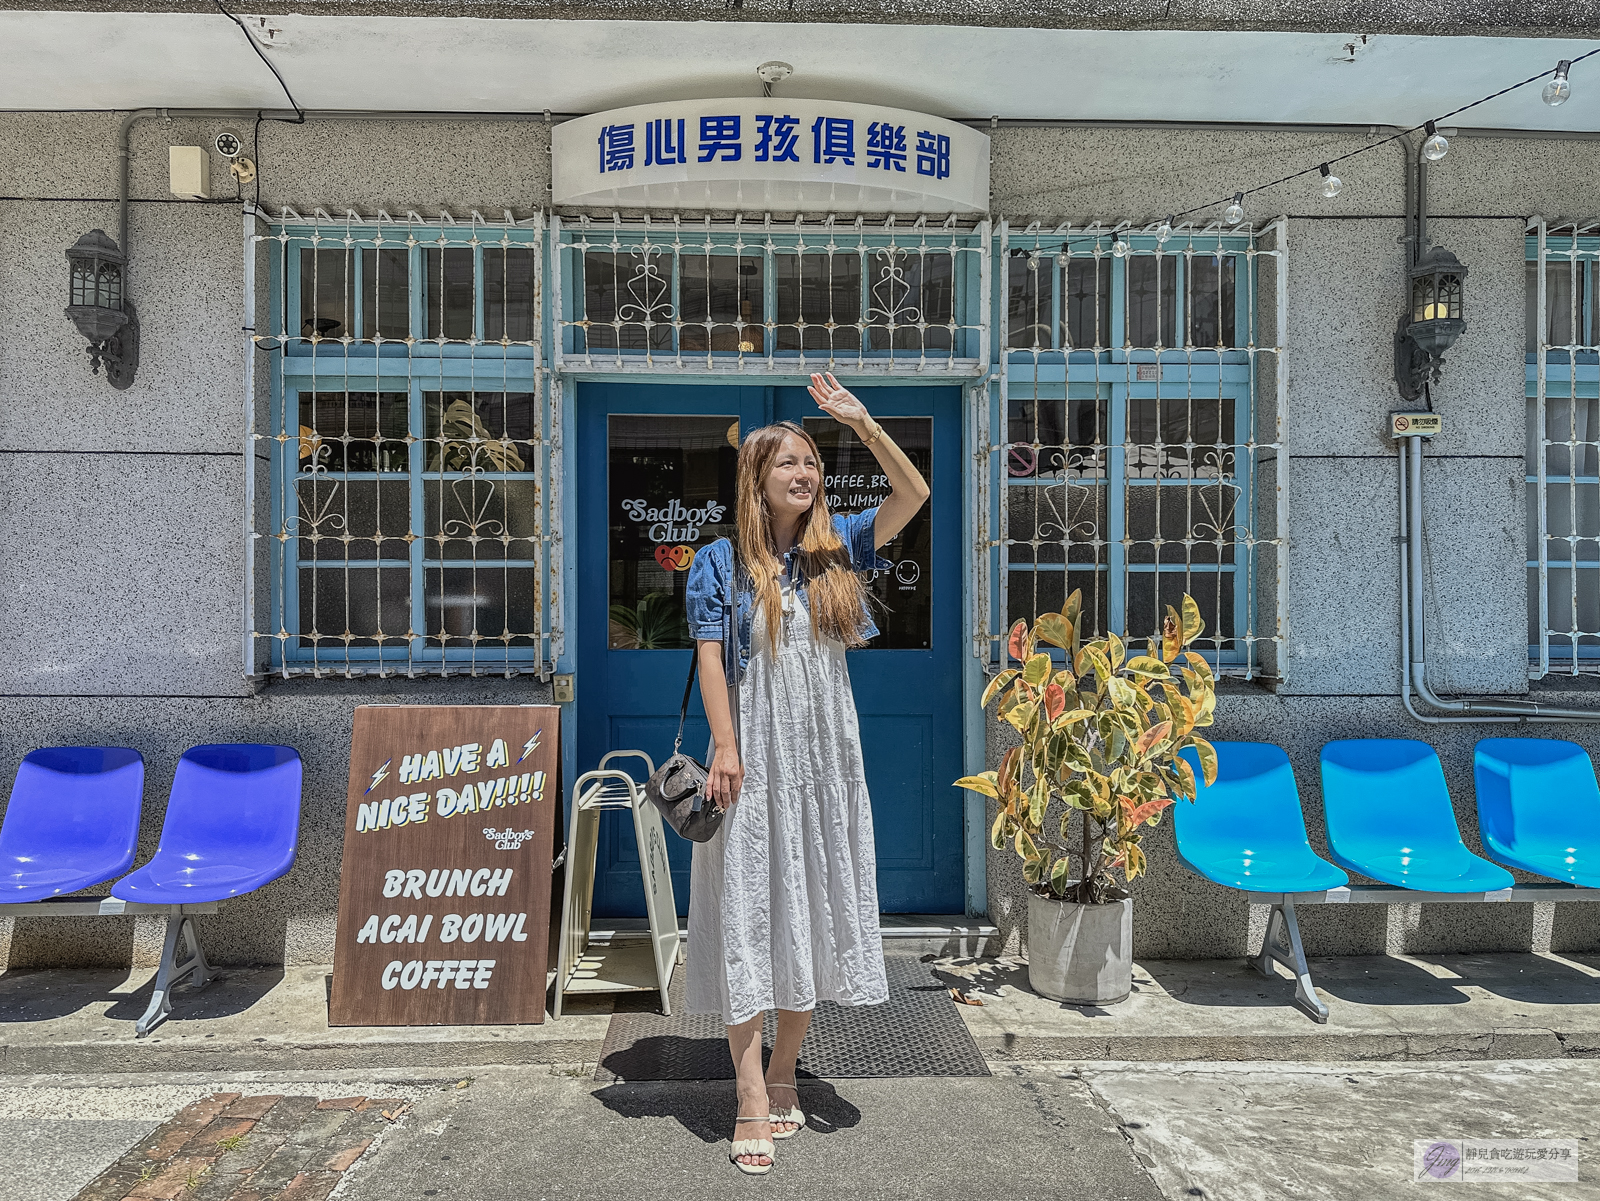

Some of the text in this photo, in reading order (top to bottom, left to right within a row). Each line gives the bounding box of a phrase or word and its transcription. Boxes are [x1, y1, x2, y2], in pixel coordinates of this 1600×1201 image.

[598, 115, 951, 180] 傷心男孩俱樂部
[649, 521, 700, 543] Club
[398, 738, 509, 786] HAVE A
[355, 771, 547, 833] NICE DAY!!!!
[495, 839, 521, 850] Club
[382, 868, 513, 900] BRUNCH
[356, 912, 528, 944] ACAI BOWL
[381, 959, 496, 990] COFFEE
